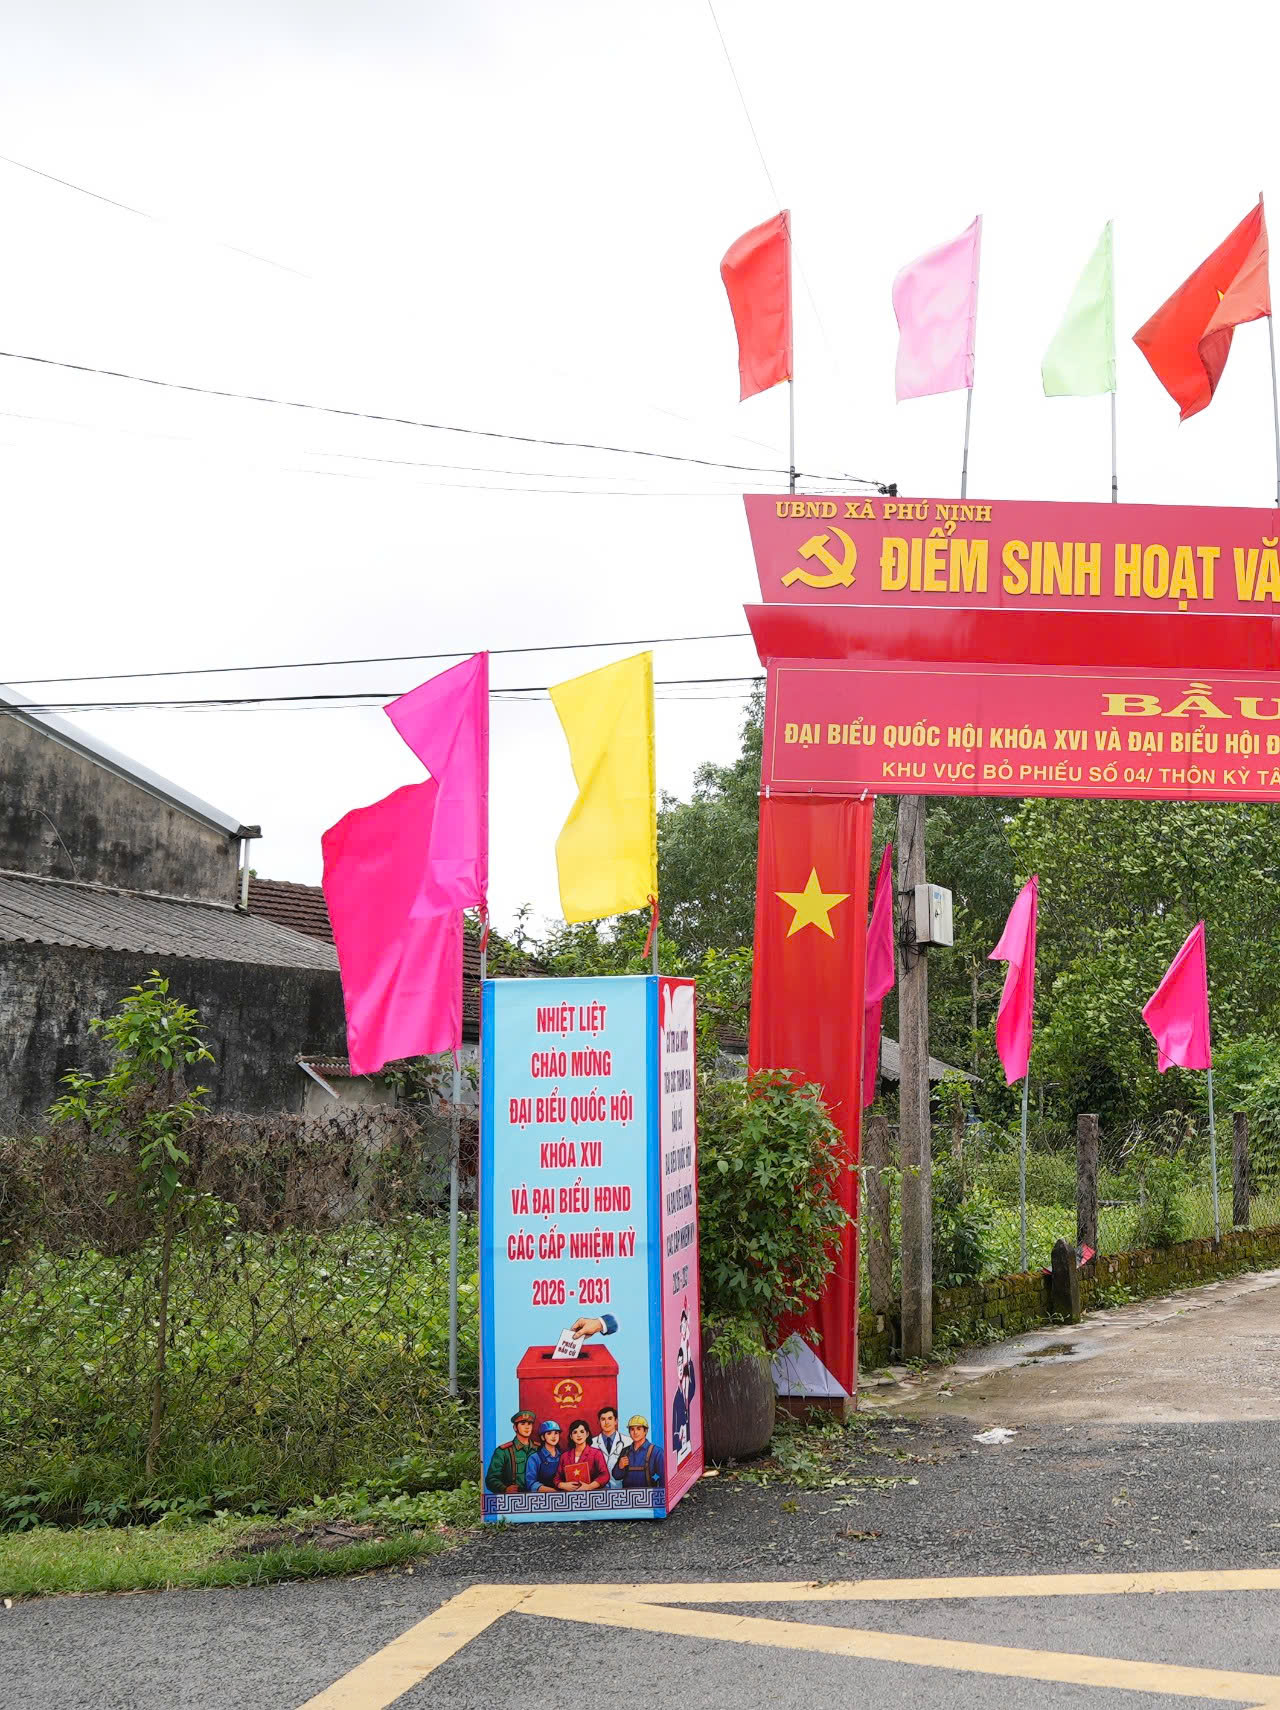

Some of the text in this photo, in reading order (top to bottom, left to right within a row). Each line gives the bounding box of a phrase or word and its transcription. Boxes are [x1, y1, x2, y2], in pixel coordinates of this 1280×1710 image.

[776, 498, 992, 522] UBND XÃ PHÚ NINH
[880, 520, 989, 593] ĐIỂM
[1001, 540, 1101, 596] SINH
[1115, 543, 1221, 612] HOẠT
[784, 723, 820, 749] ĐẠI
[827, 716, 876, 747] BIỂU
[883, 718, 940, 749] QUỐC
[947, 723, 986, 753] HỘI
[990, 724, 1047, 750] KHÓA
[1053, 729, 1088, 751] XVI
[1095, 727, 1121, 751] VÀ
[1128, 731, 1163, 757] ĐẠI
[1171, 724, 1218, 753] BIỂU
[1225, 730, 1259, 759] HỘI
[882, 762, 926, 778] KHU
[933, 762, 975, 782] VỰC
[983, 758, 1013, 780] BỎ
[1019, 759, 1082, 781] PHIẾU
[1089, 761, 1117, 783] SỐ
[1124, 766, 1153, 784] 04/
[1159, 765, 1216, 785] THÔN
[1223, 765, 1250, 785] KỲ
[536, 1000, 606, 1037] NHIỆT LIỆT
[531, 1046, 611, 1078] CHÀO MỪNG
[509, 1087, 634, 1129] ĐẠI BIỂU QUỐC HỘI
[540, 1137, 602, 1168] KHÓA XVI
[511, 1177, 632, 1219] VÀ ĐẠI BIỂU HĐND
[507, 1224, 636, 1264] CÁC CẤP NHIỆM KỲ
[532, 1279, 565, 1305] 2026
[579, 1278, 610, 1304] 2031
